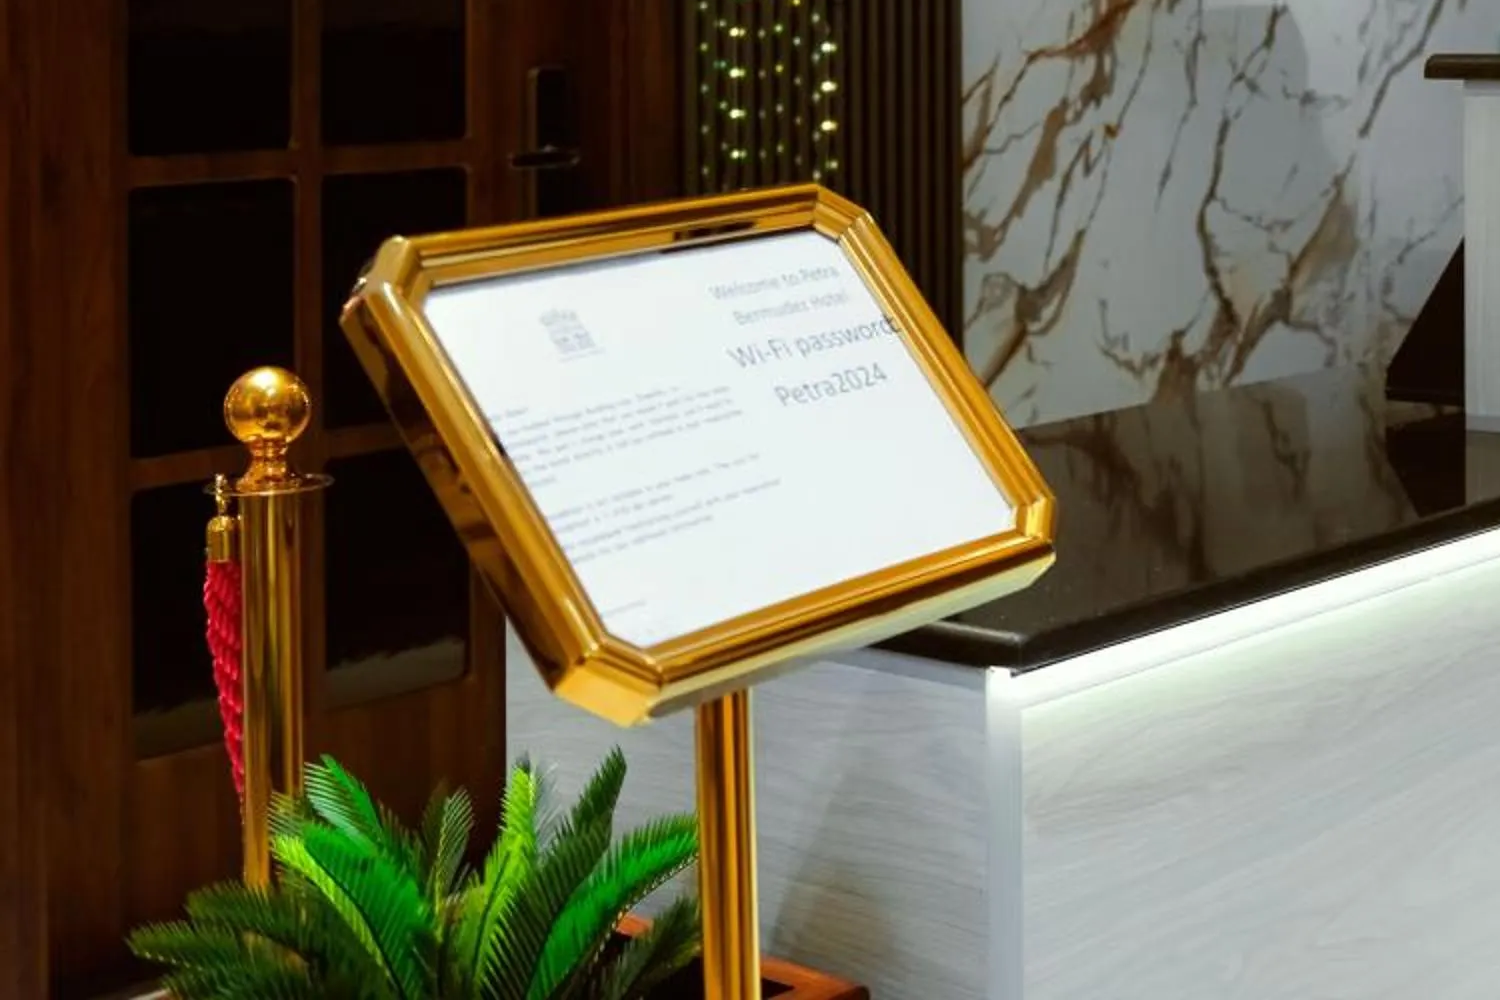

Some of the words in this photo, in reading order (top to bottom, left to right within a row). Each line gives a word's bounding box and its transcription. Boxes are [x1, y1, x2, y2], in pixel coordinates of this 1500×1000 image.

[708, 278, 779, 299] Welcome
[781, 272, 799, 287] to
[799, 265, 840, 283] Petra
[726, 337, 793, 369] Wi-Fi
[796, 313, 904, 360] password
[774, 362, 888, 407] Petra2024
